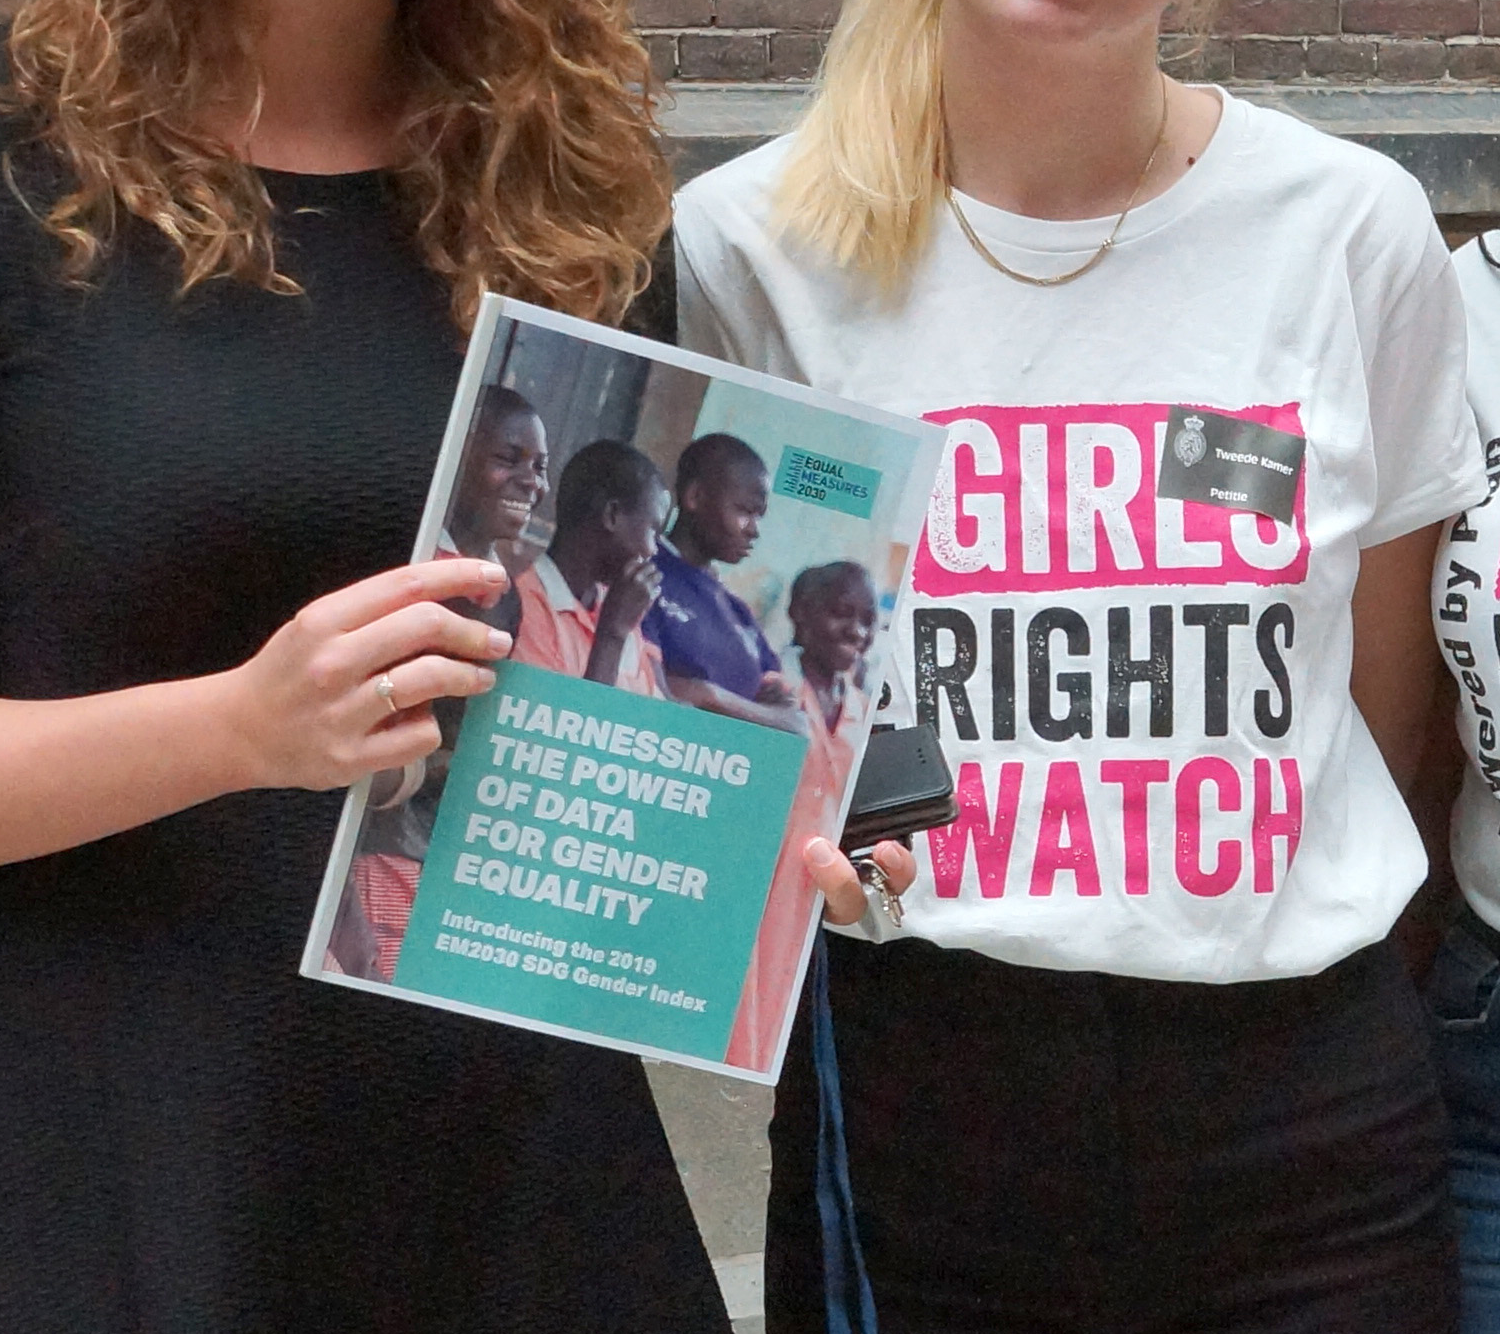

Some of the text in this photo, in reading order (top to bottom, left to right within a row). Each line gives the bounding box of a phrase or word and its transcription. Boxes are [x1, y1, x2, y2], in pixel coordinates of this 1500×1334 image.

[797, 483, 827, 501] 2030
[801, 470, 868, 499] MEASURES
[803, 456, 844, 479] EQUAL
[1210, 487, 1248, 502] Petitie
[1215, 448, 1294, 476] Tweede Kamer
[1440, 560, 1480, 623] by
[913, 602, 1295, 741] RIGHTS
[496, 695, 751, 786] HARNESSING
[476, 775, 635, 841] OF DATA
[490, 734, 712, 818] THE POWER
[465, 813, 708, 900] FOR GENDER
[927, 756, 1302, 898] WATCH
[454, 853, 653, 925] EQUALITY
[435, 933, 708, 1012] EM2030 SDG Gender Index
[441, 909, 657, 975] Introducing the 2019
